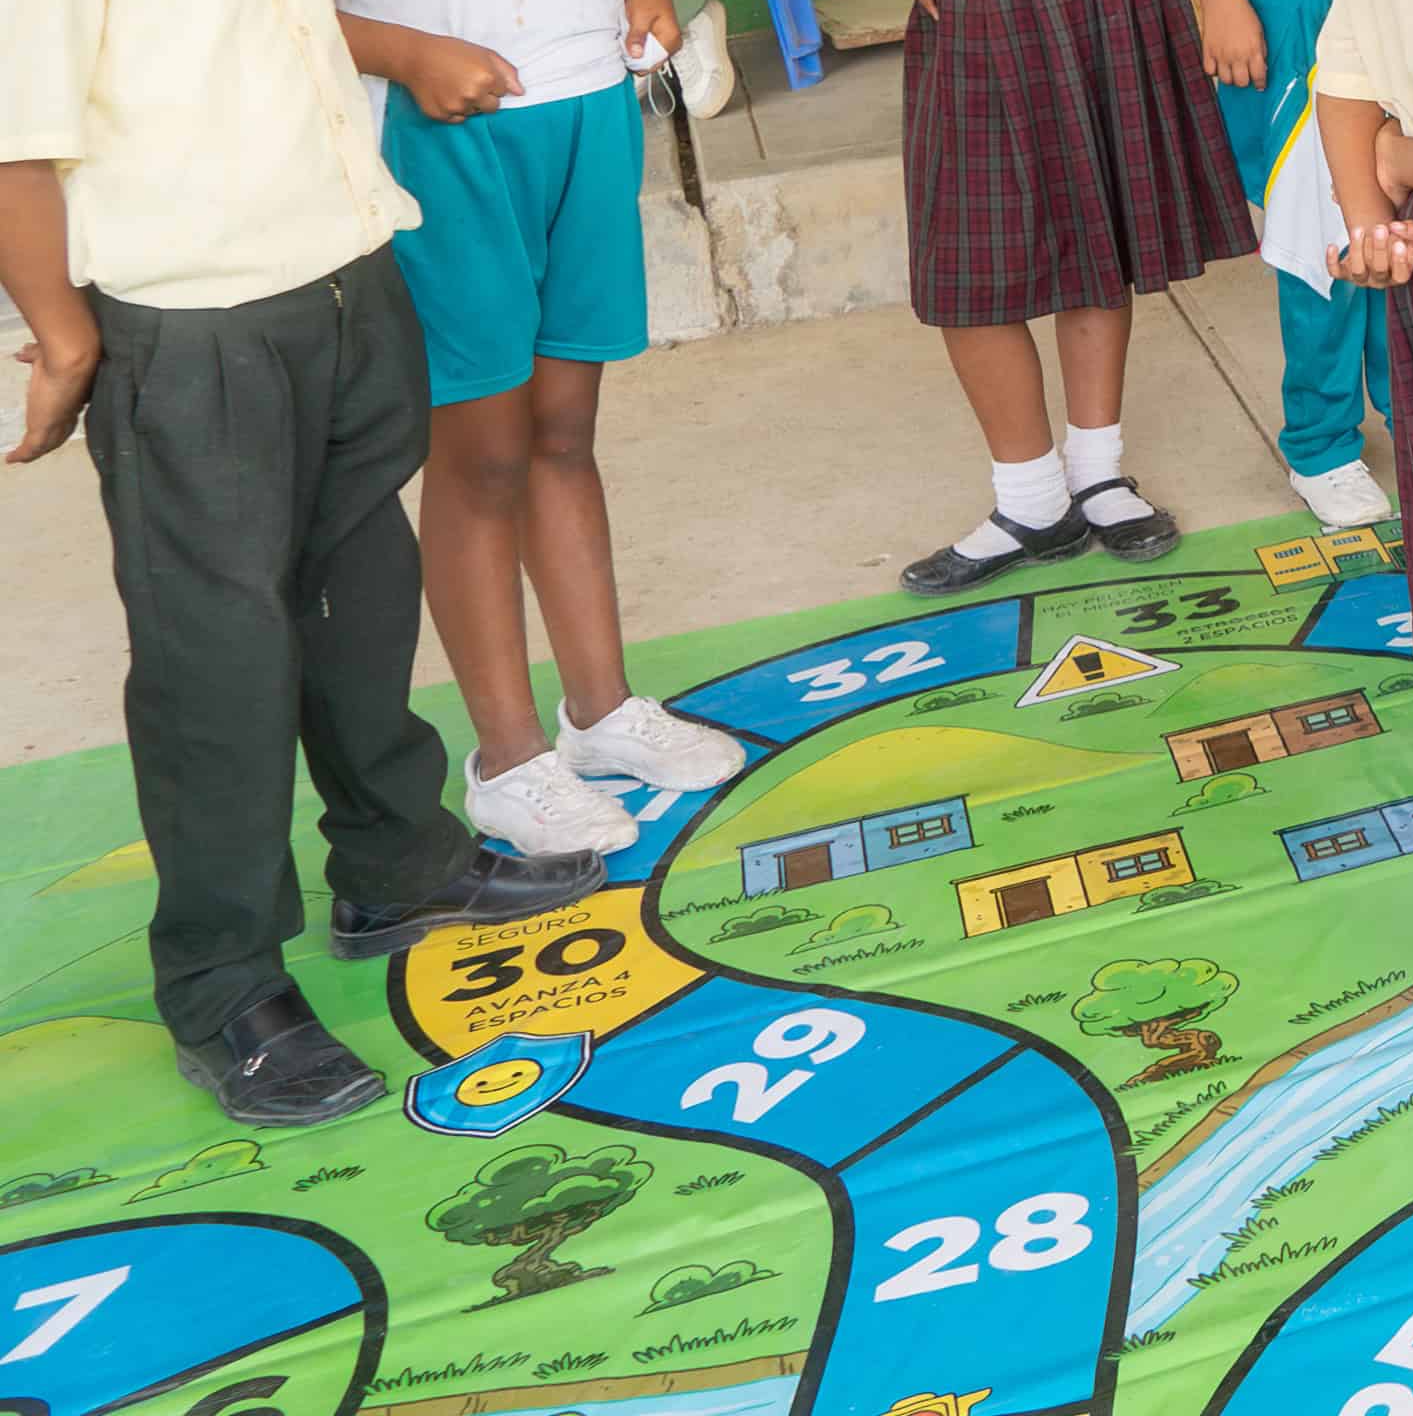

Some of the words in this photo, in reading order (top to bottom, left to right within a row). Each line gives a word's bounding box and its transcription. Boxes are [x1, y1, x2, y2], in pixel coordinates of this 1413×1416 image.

[1115, 586, 1241, 635] 33
[1199, 614, 1299, 642] ESPACIOS
[786, 640, 946, 703] 32
[455, 911, 593, 951] SEGURO
[440, 927, 627, 1002] 30
[464, 974, 604, 1020] AVANZA
[613, 969, 634, 982] 4
[467, 985, 629, 1033] ESPACIOS
[680, 1007, 866, 1123] 29
[873, 1191, 1093, 1304] 28
